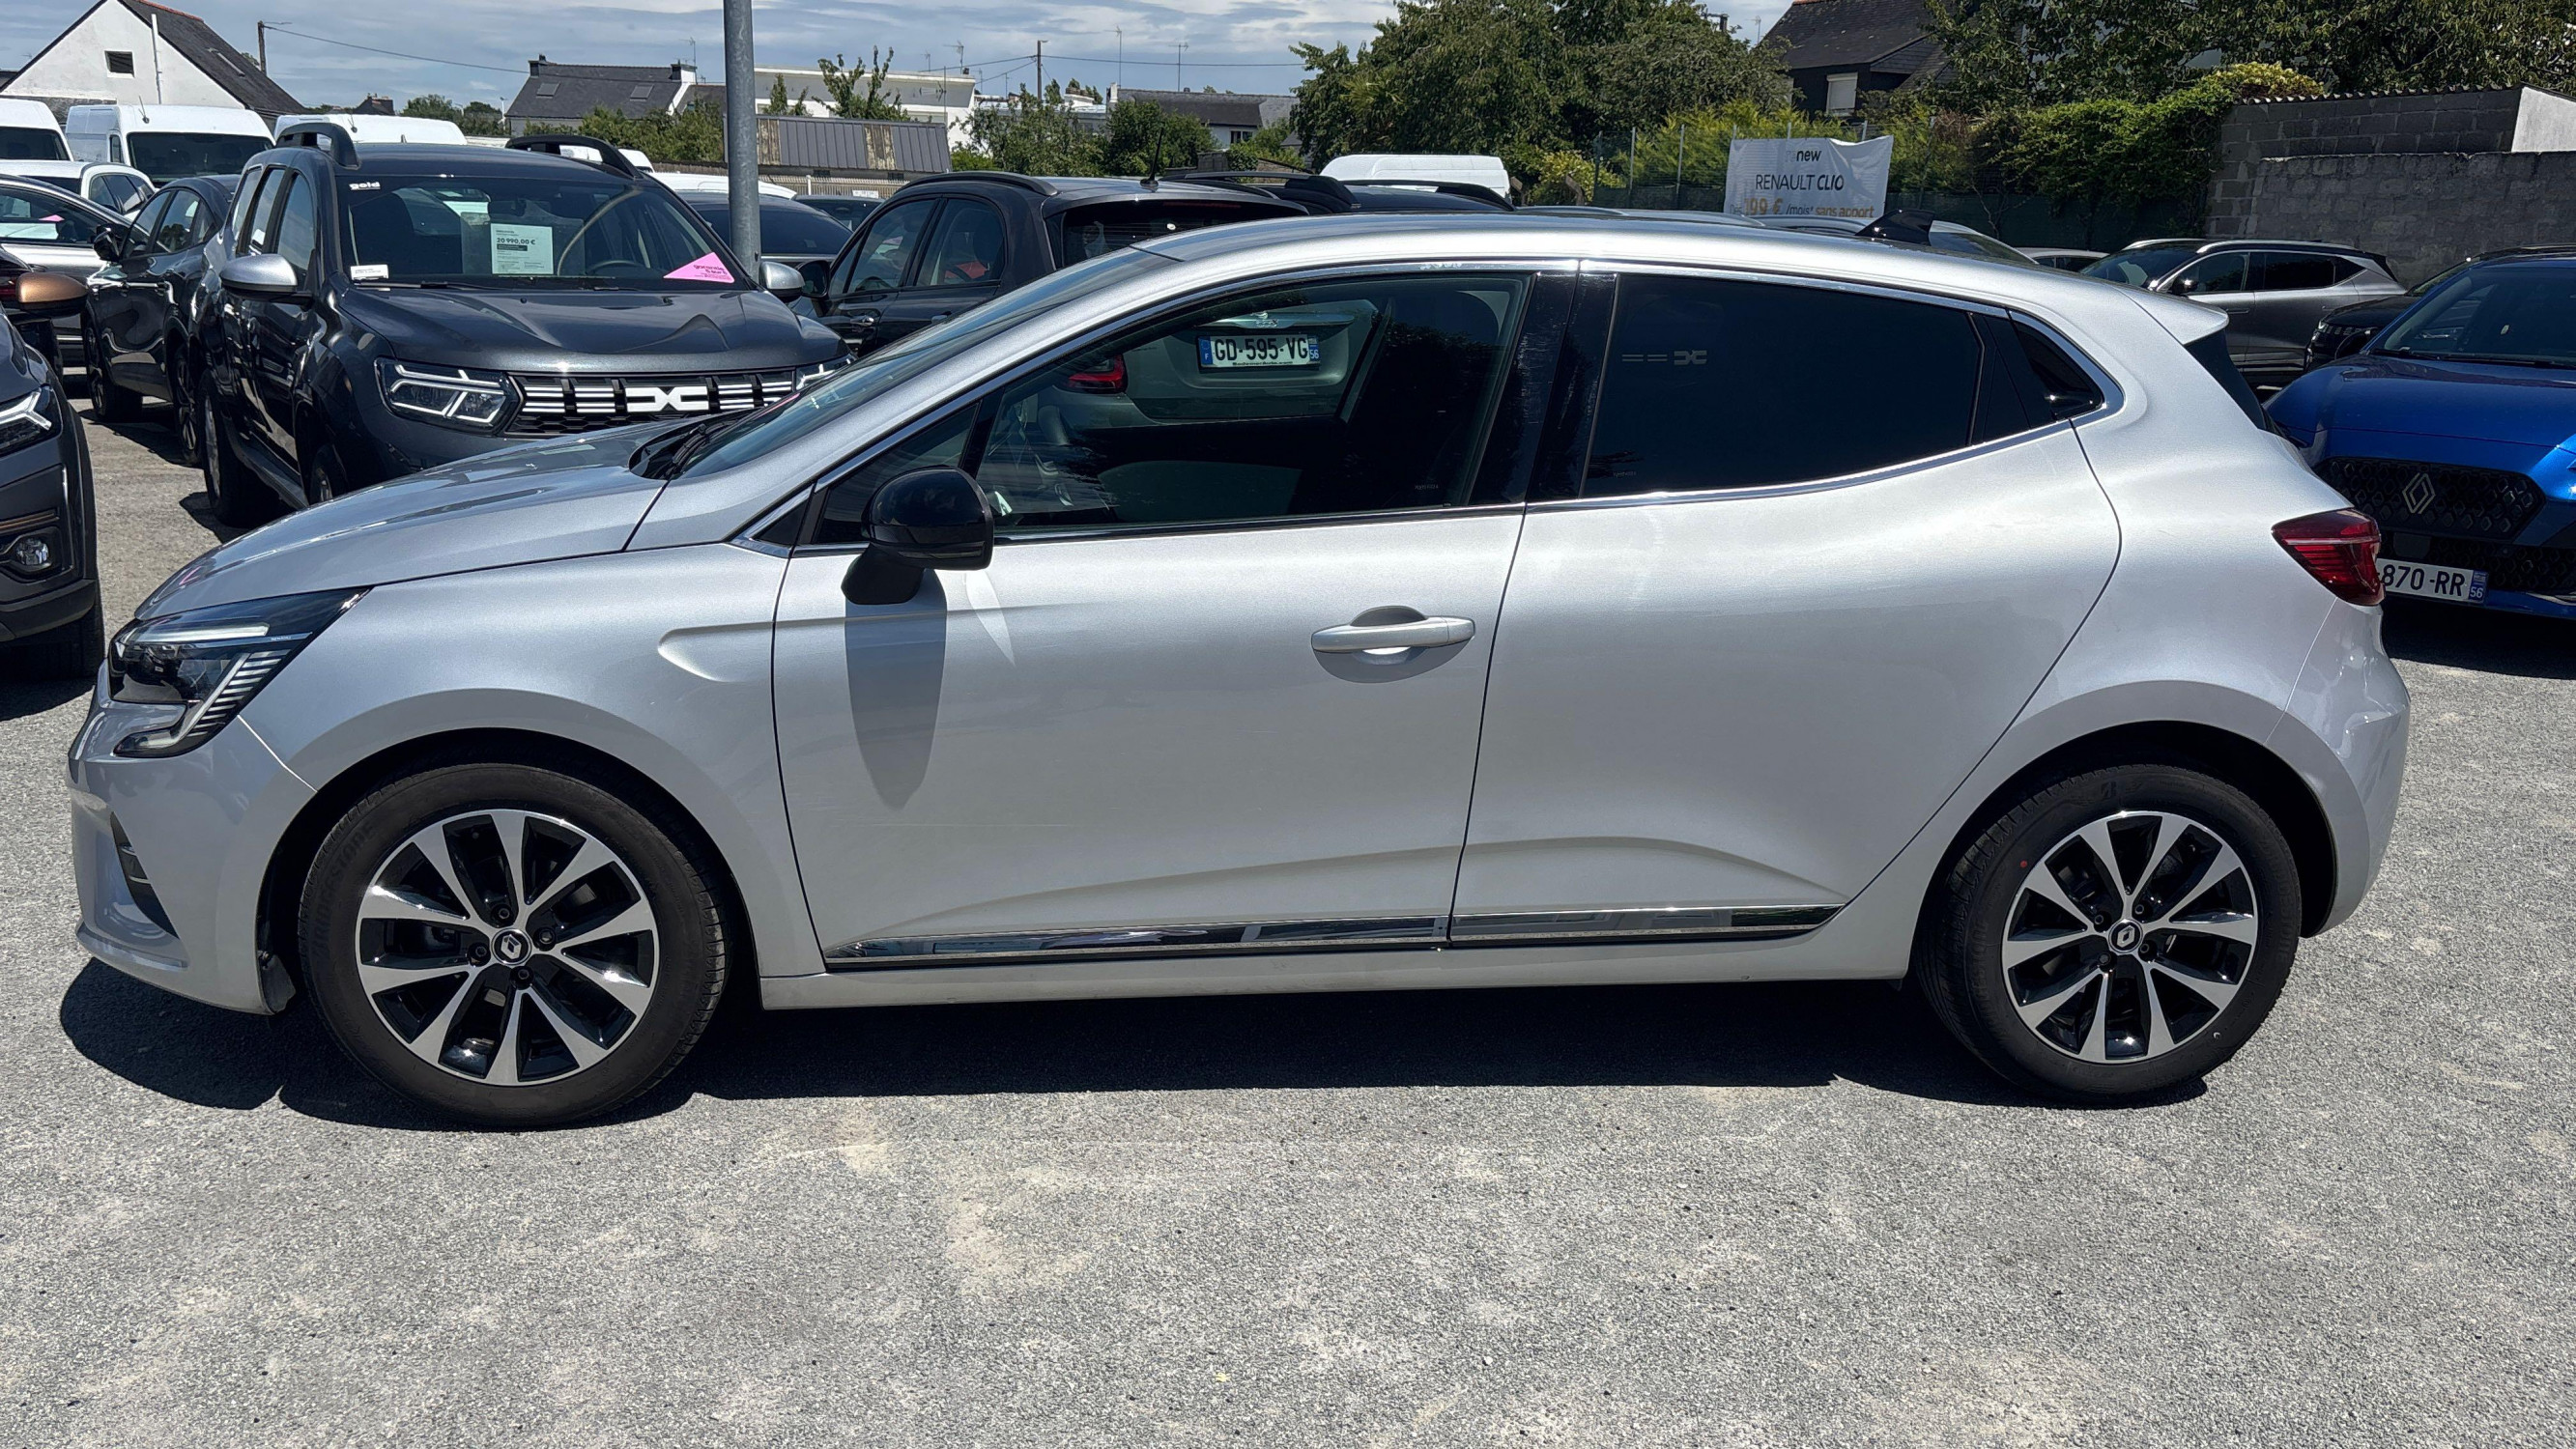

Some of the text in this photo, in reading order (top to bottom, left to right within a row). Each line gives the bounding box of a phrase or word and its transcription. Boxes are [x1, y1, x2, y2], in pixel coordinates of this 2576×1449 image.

[349, 182, 381, 190] gold
[1755, 174, 1845, 190] RENAULT CLIO
[1815, 206, 1838, 216] sans
[1214, 337, 1308, 361] GD-595-VG
[1309, 349, 1320, 359] 56
[2470, 586, 2484, 598] 56
